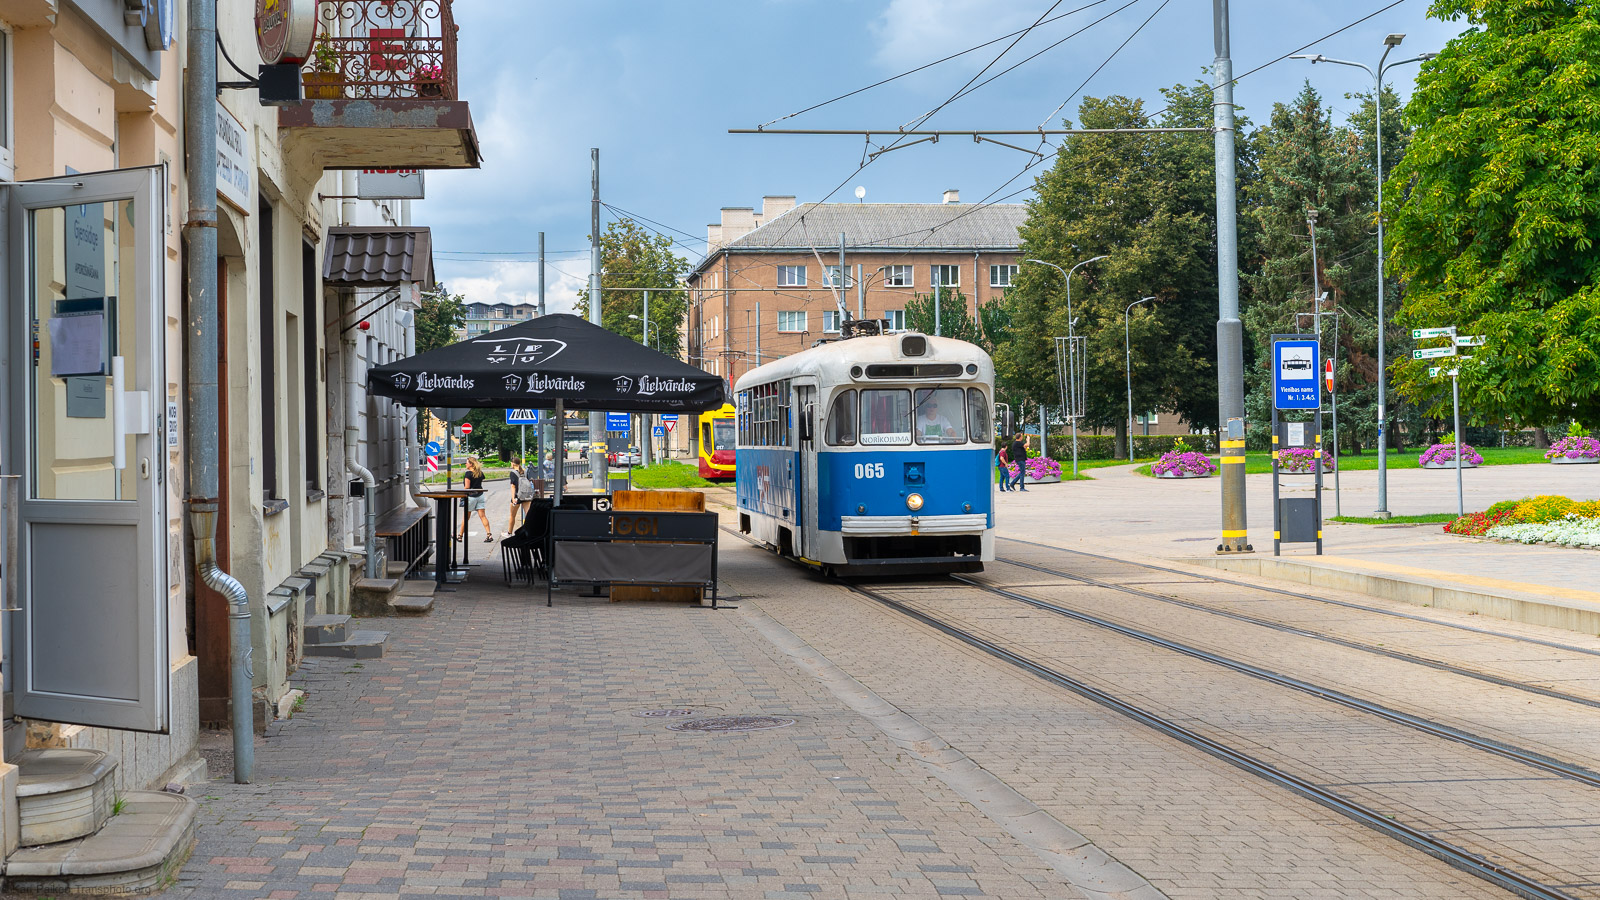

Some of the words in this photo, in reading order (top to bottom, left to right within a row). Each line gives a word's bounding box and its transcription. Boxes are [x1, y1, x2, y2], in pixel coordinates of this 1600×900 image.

[416, 371, 475, 392] Lielvārdes
[526, 373, 586, 393] Lielvārdes
[637, 375, 696, 395] Lielvārdes
[862, 435, 910, 444] NORĪKOJUMA
[854, 463, 885, 479] 065
